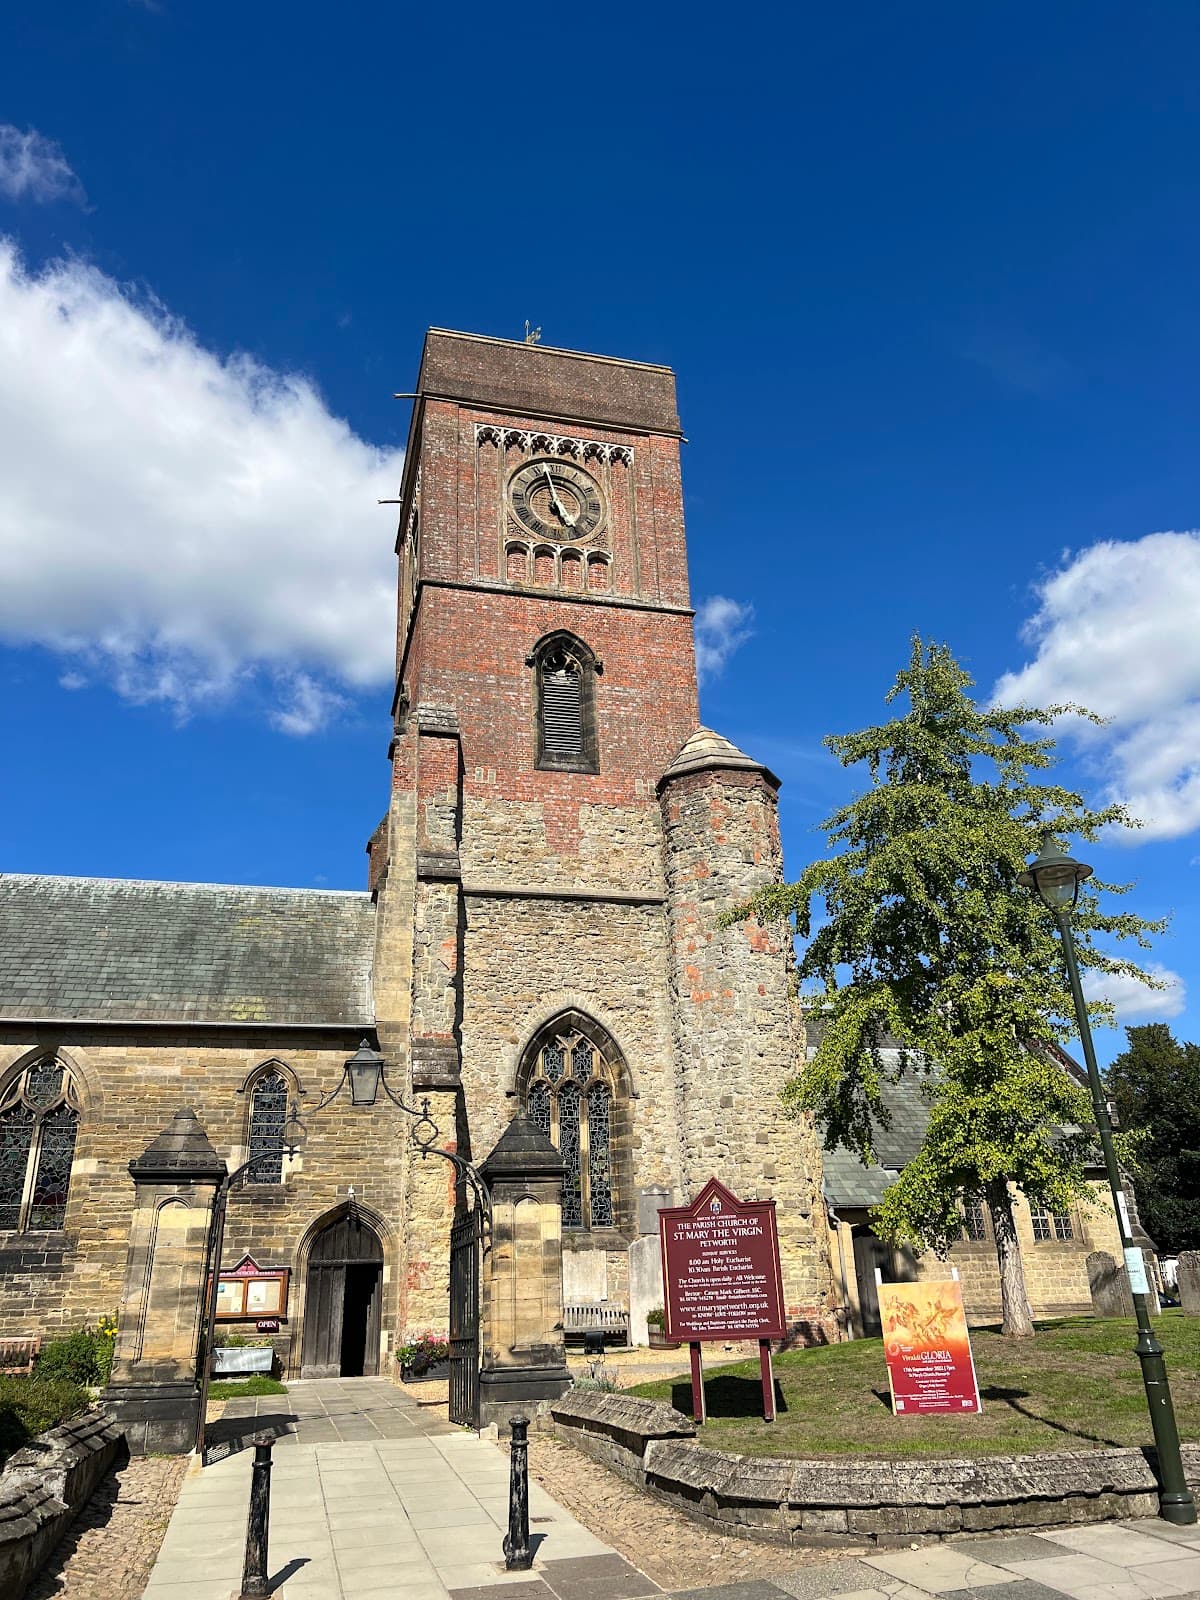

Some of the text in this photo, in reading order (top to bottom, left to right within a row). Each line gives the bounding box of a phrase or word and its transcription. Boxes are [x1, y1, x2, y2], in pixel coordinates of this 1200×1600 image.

[693, 1221, 716, 1229] PARISH
[717, 1218, 747, 1227] CHURCH
[686, 1230, 710, 1239] MARY
[711, 1229, 731, 1237] THE
[732, 1227, 762, 1236] VIRGIN
[700, 1239, 737, 1247] PETWORTH
[920, 1349, 952, 1361] GLORIA
